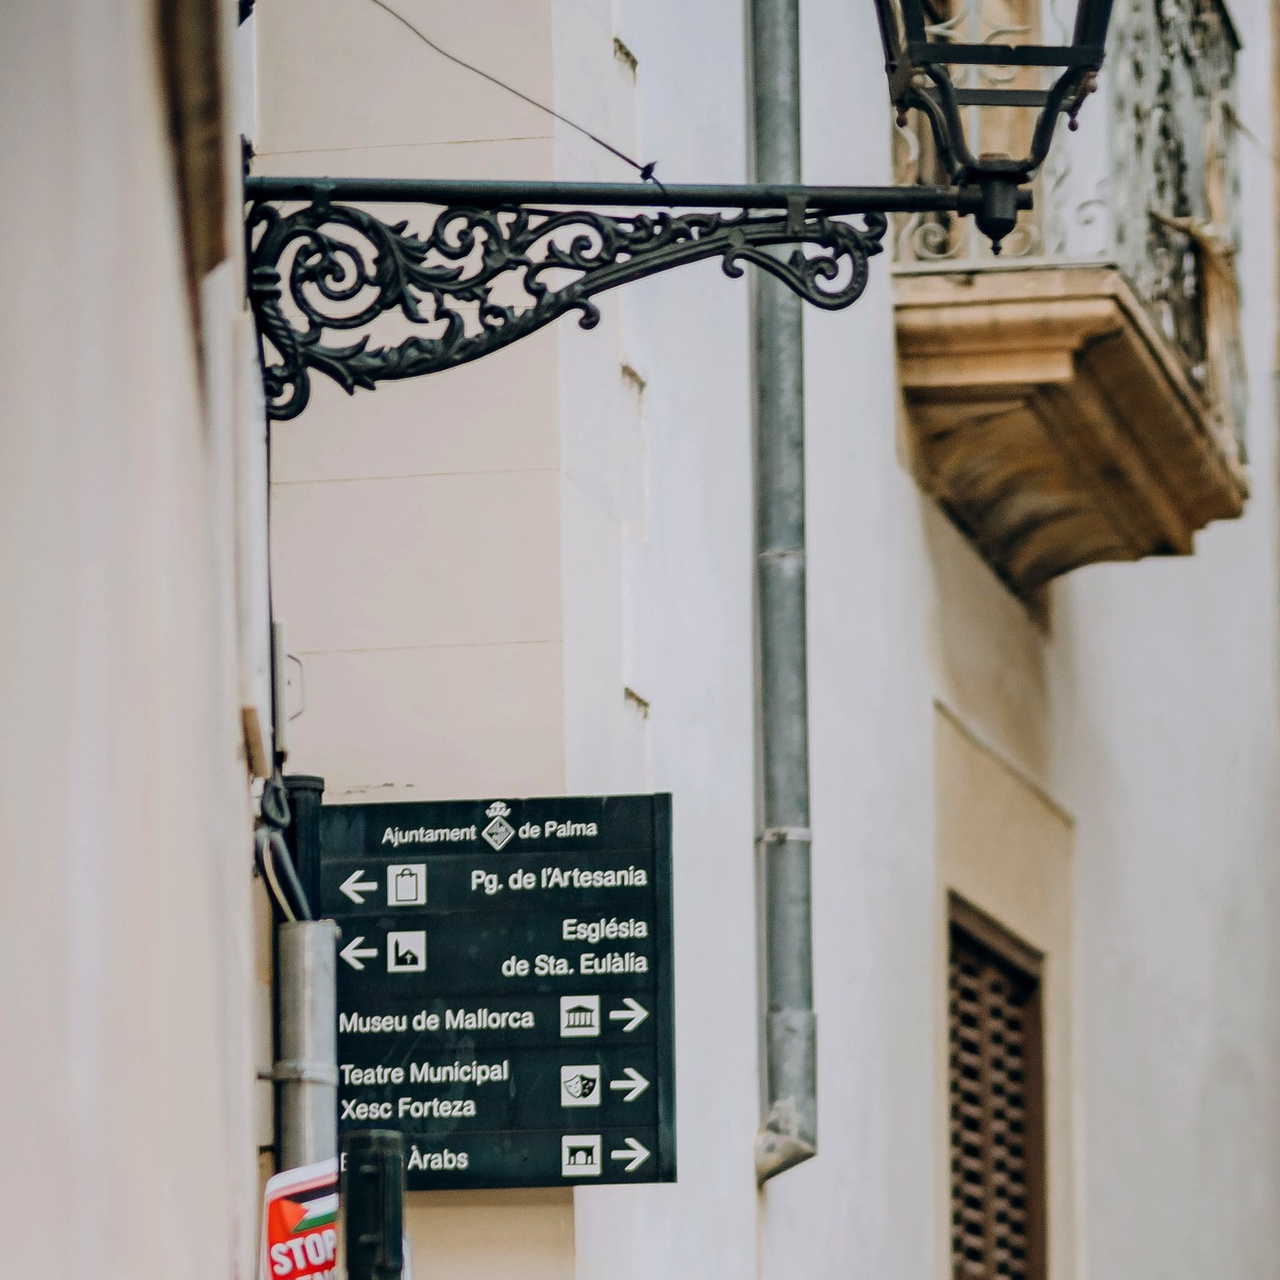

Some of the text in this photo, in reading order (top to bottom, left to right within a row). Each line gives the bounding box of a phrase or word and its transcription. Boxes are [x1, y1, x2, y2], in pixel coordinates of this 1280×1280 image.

[382, 820, 598, 846] Ajuntament de Palma
[471, 870, 503, 895] Pg.
[509, 869, 536, 890] de
[562, 918, 648, 944] Església
[502, 952, 648, 977] de Sta. Eulàlia
[339, 1008, 535, 1034] Museu de Mallorca
[340, 1060, 509, 1086] Teatre Municipal
[341, 1097, 476, 1120] Xesc Forteza
[407, 1145, 469, 1171] Àrabs
[270, 1228, 337, 1276] STOP
